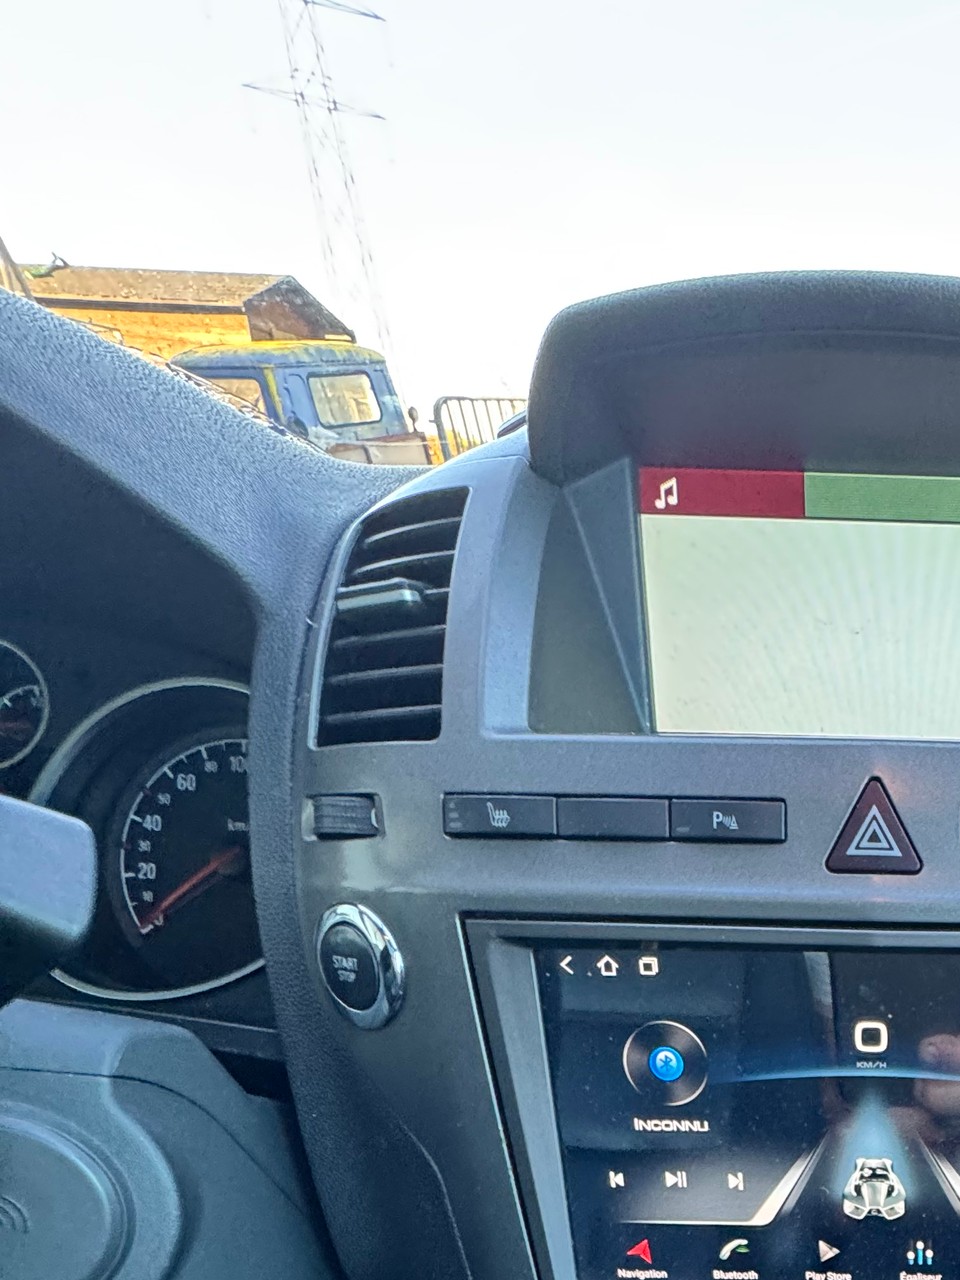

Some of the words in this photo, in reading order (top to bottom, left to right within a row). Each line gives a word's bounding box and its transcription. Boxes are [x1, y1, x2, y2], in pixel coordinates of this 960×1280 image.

[176, 773, 196, 792] 60
[142, 814, 163, 832] 40
[137, 862, 157, 880] 20
[332, 955, 359, 971] START
[855, 1060, 888, 1069] KM/H
[712, 1269, 759, 1280] Bluetooth
